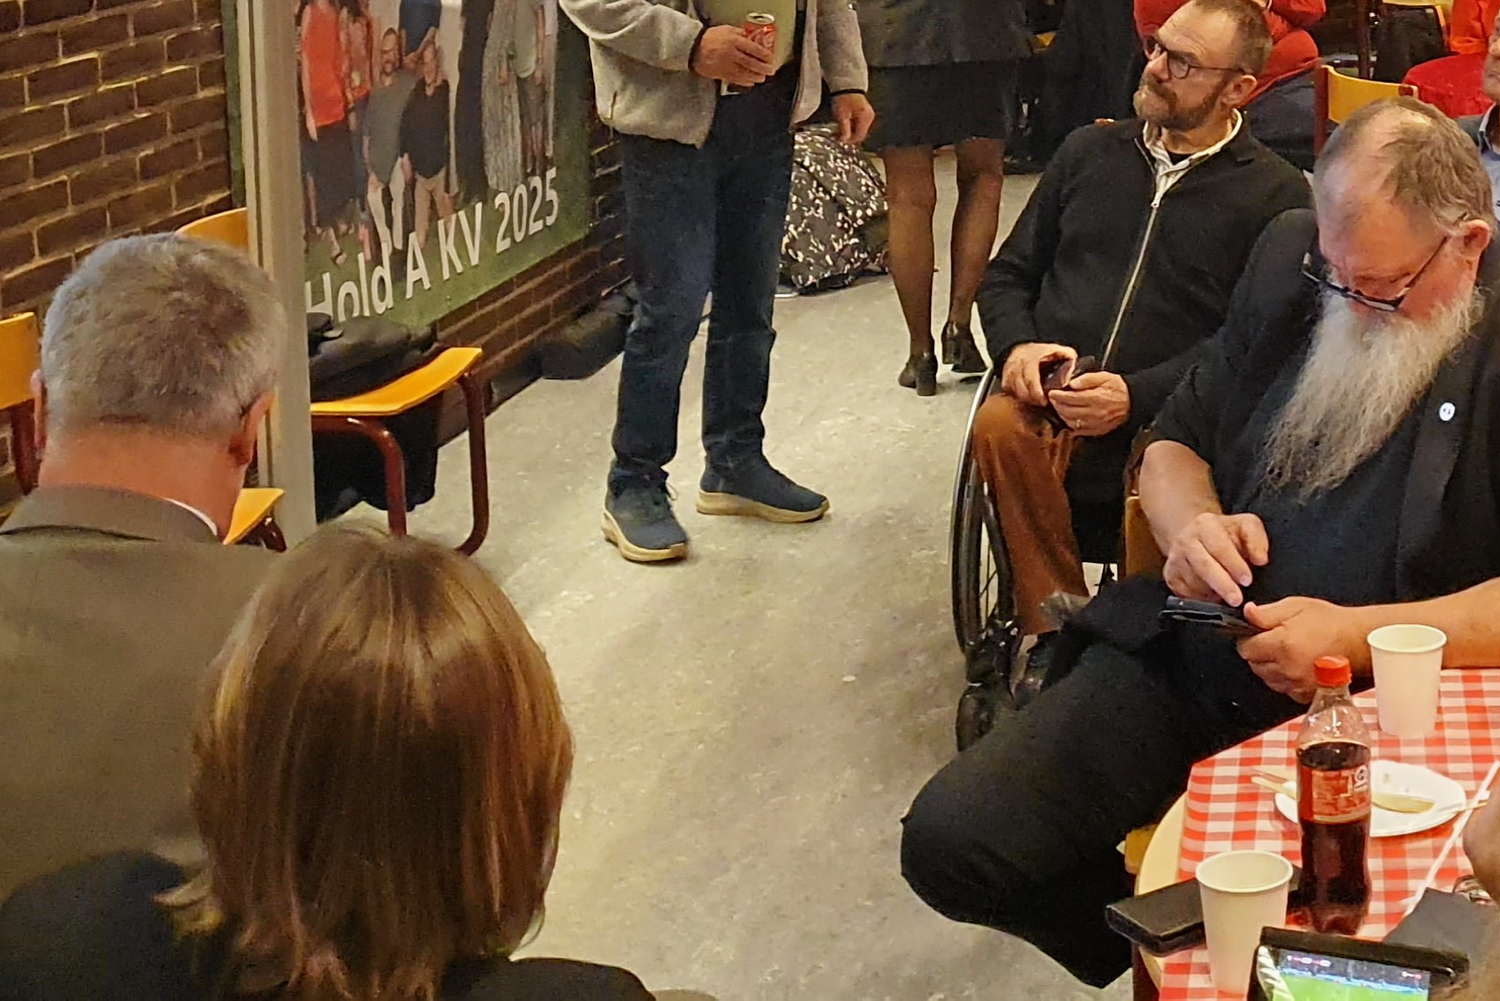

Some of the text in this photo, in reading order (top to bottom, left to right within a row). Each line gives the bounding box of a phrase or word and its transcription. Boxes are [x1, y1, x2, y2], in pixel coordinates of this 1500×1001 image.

[304, 166, 559, 322] Hold A KV 2025
